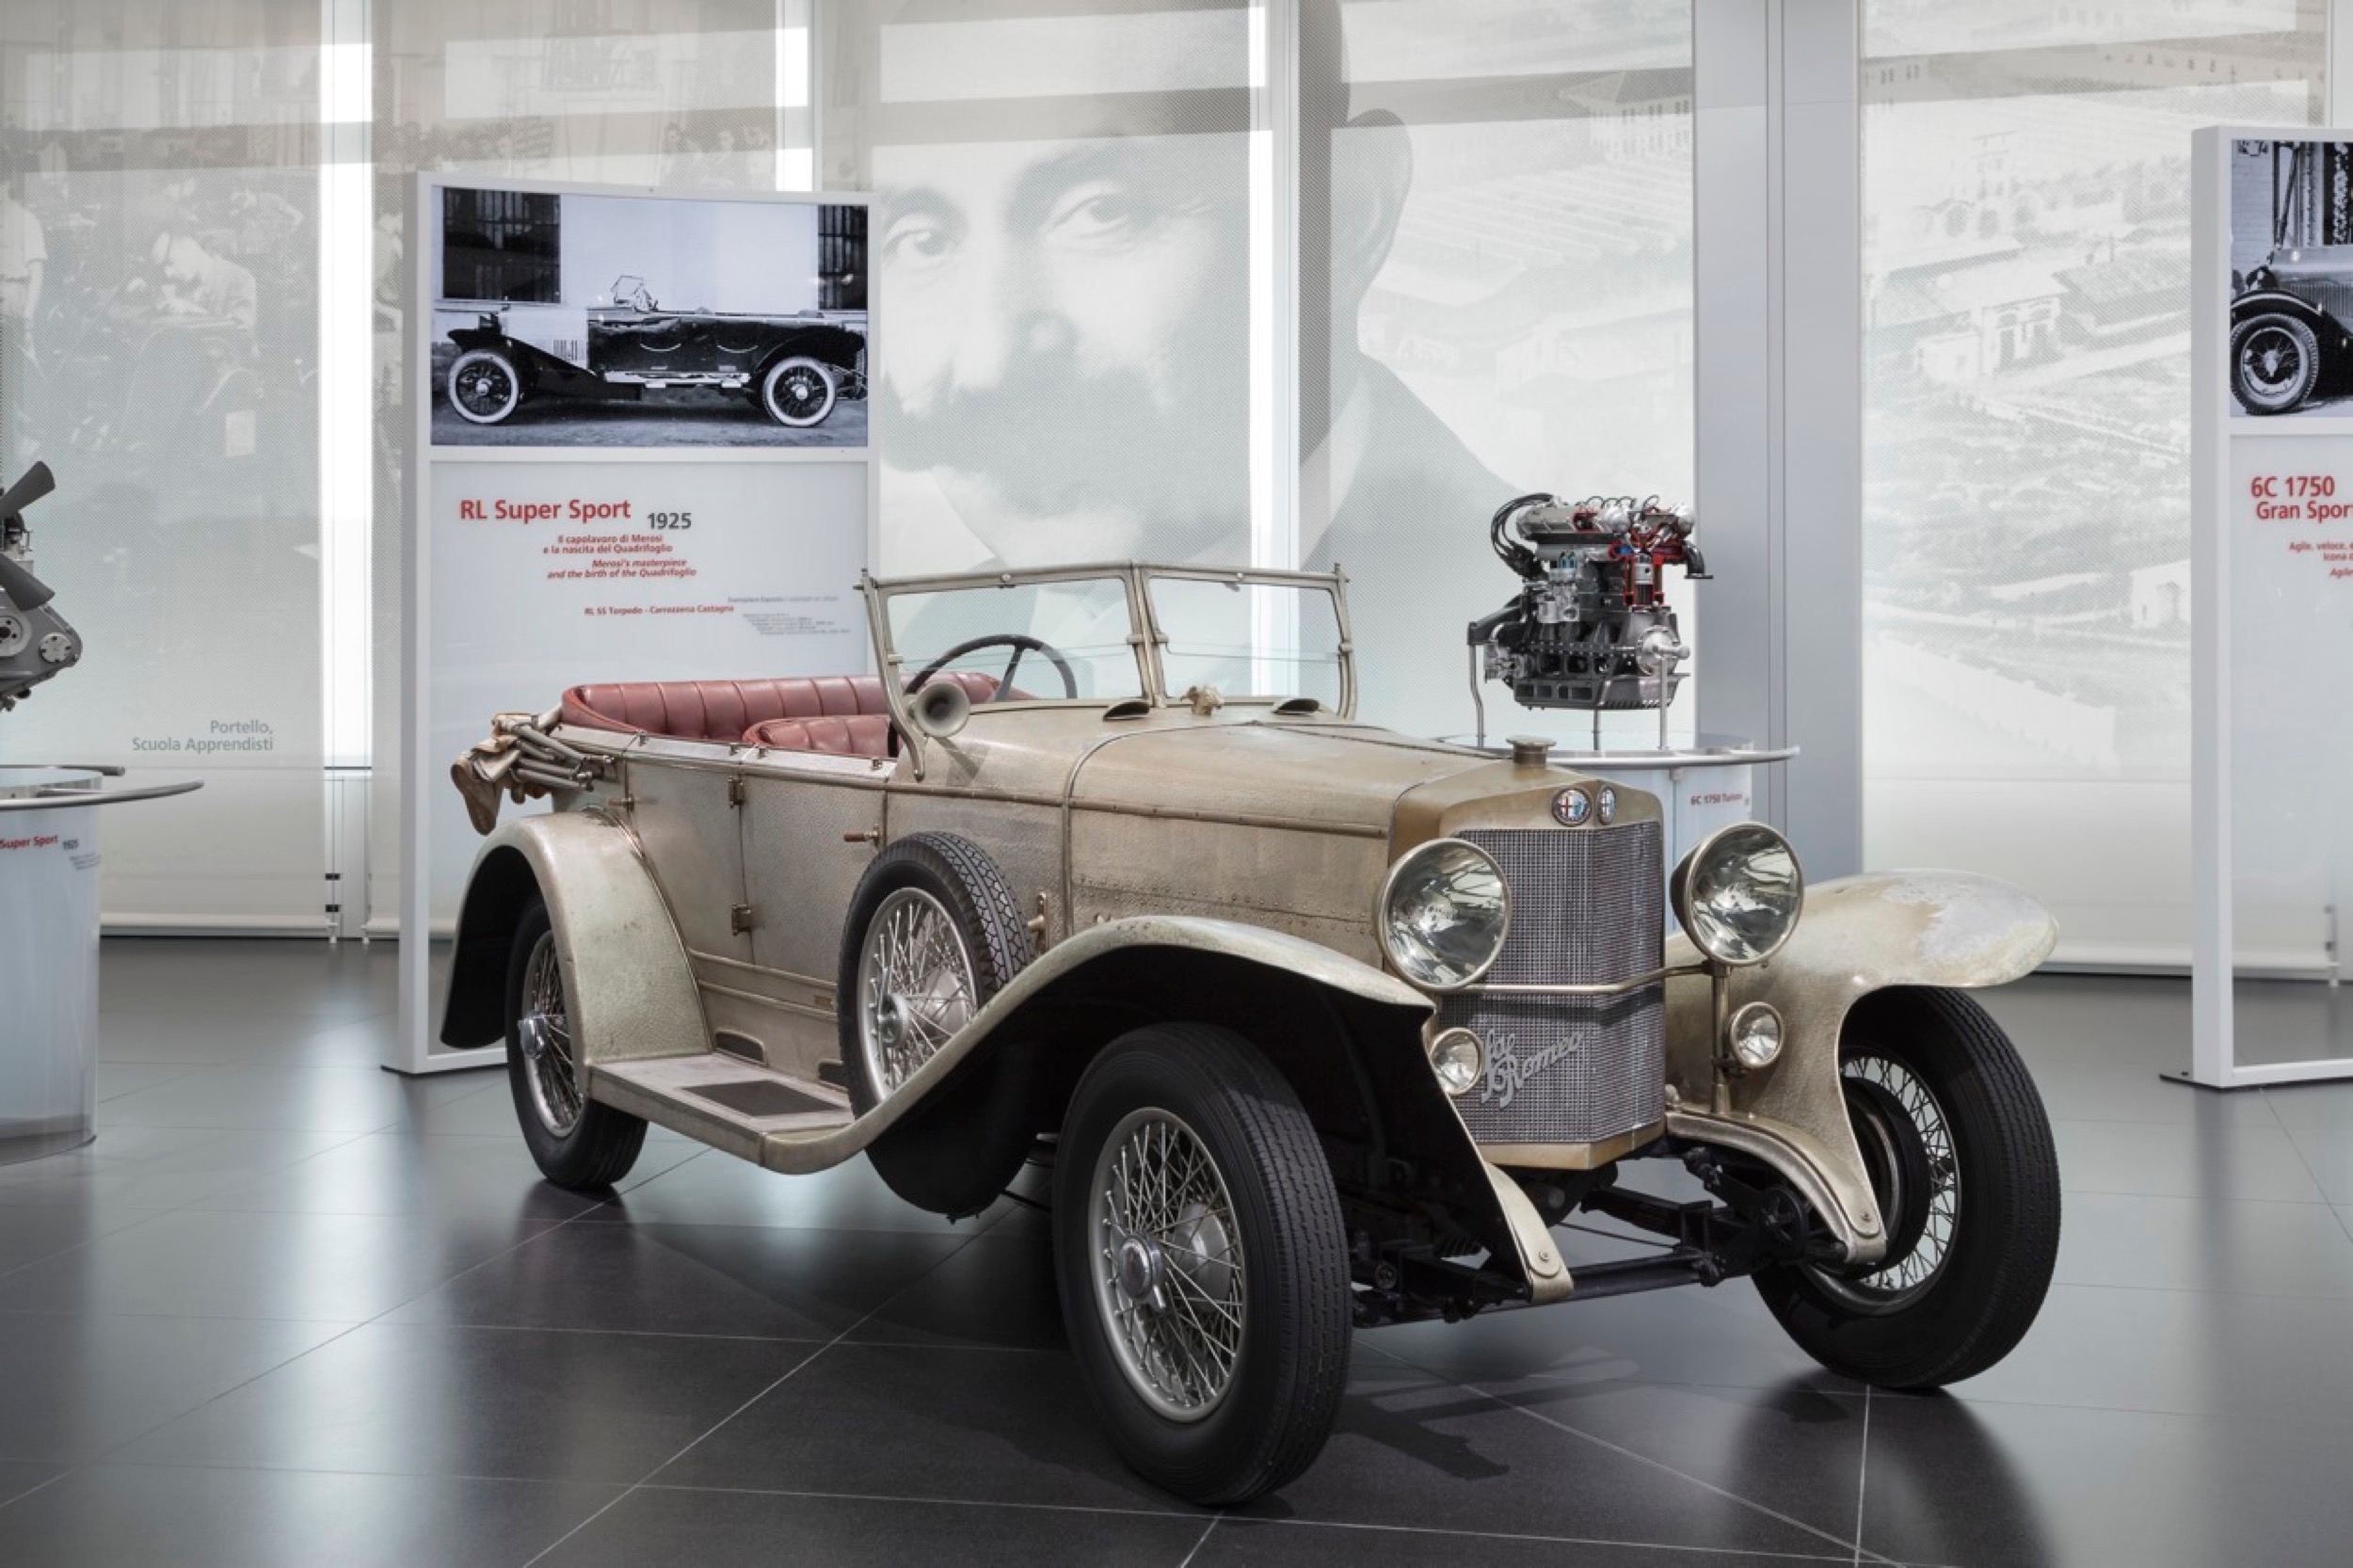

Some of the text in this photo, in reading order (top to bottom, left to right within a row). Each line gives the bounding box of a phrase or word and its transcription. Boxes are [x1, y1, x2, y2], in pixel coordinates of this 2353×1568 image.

[2250, 475, 2335, 498] 6C 1750
[459, 498, 632, 524] RL Super Sport
[2256, 500, 2353, 523] Gran Spor
[647, 512, 692, 530] 1925
[566, 535, 617, 545] capolavoro
[619, 535, 629, 543] di
[632, 535, 663, 543] Merosi
[562, 545, 594, 554] nascita
[597, 545, 611, 553] del
[613, 544, 673, 554] Quadrifoglio
[591, 558, 687, 569] Merosi's masterpiece
[547, 567, 696, 579] and the birth of the Quadrifoglio
[210, 719, 273, 735] Portello,
[132, 737, 273, 754] Scuola Apprendisti
